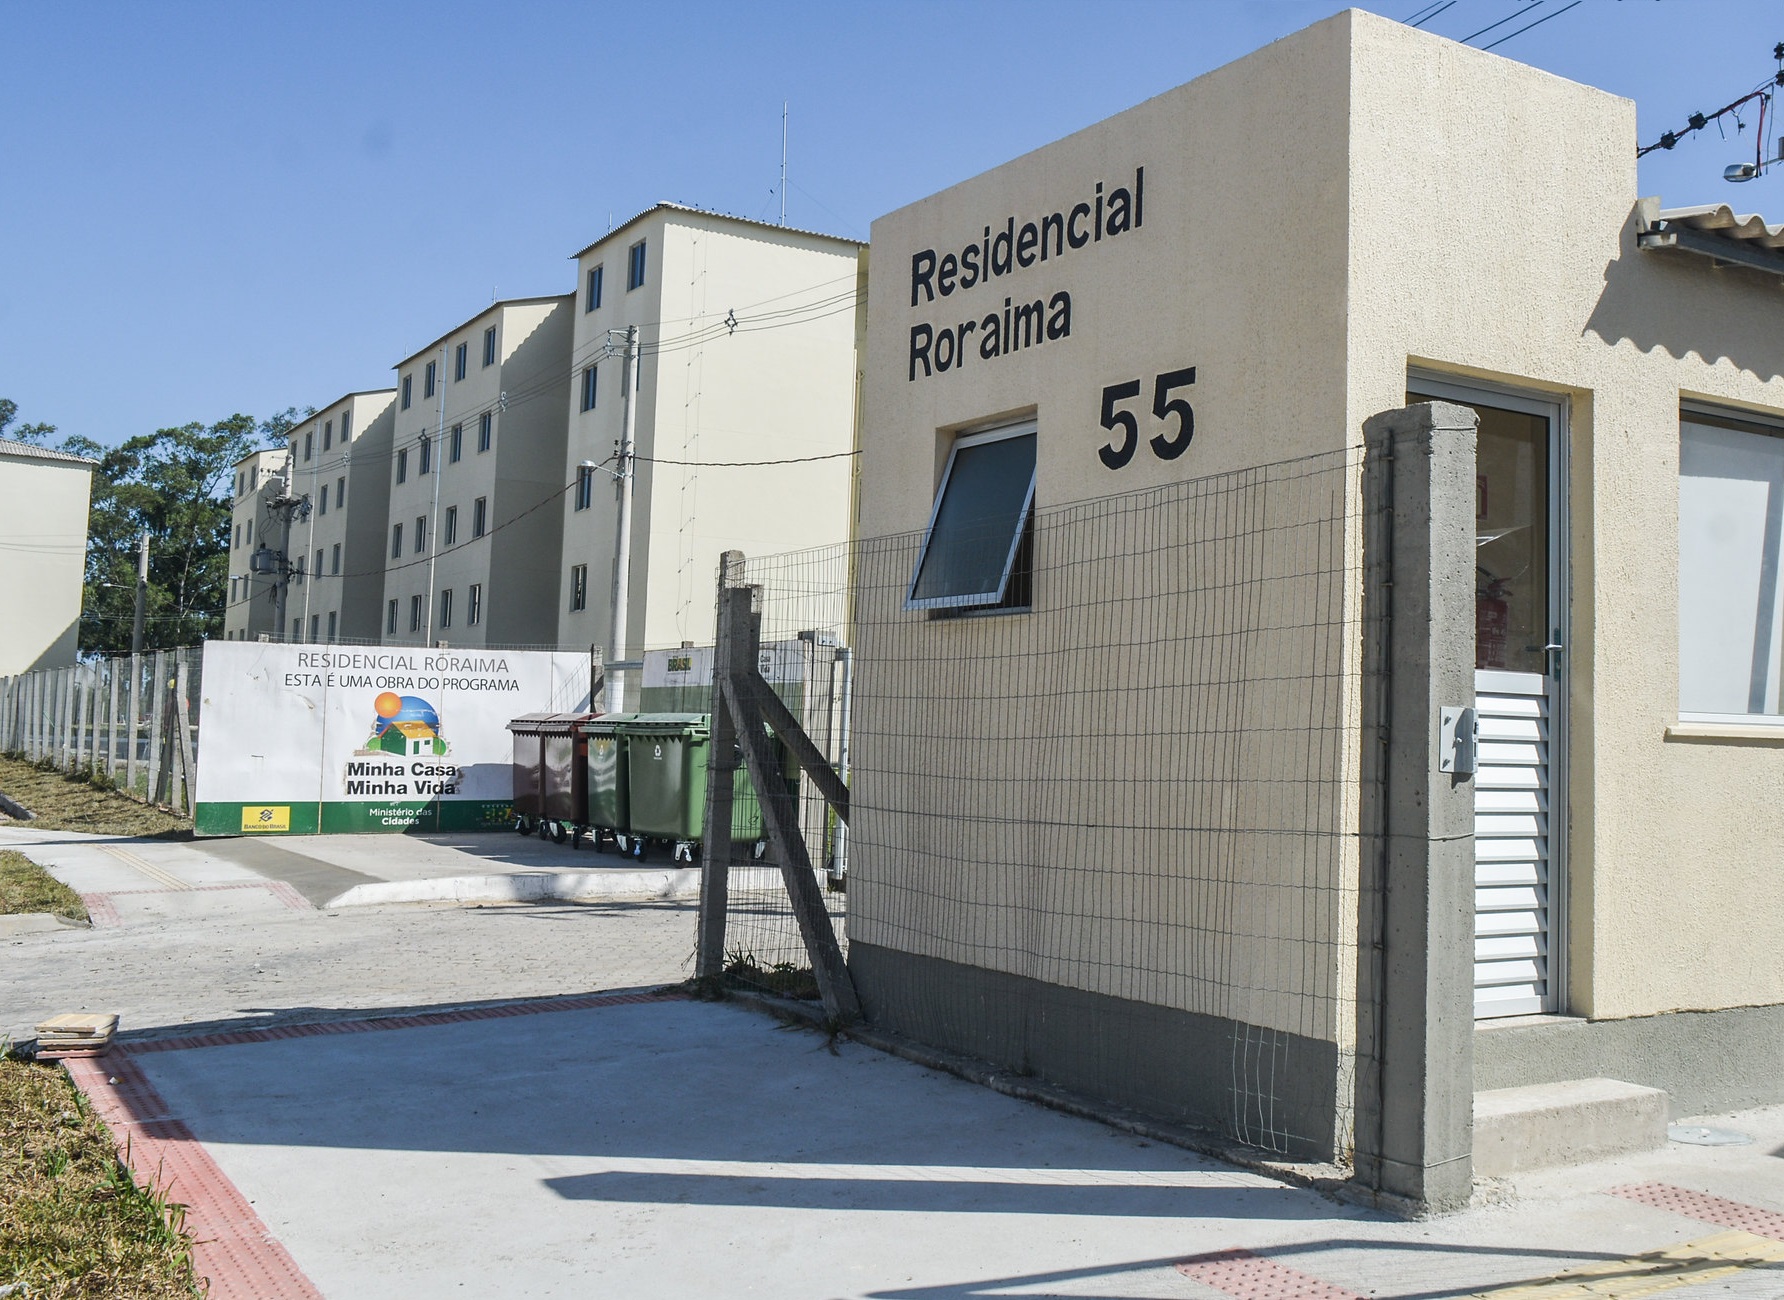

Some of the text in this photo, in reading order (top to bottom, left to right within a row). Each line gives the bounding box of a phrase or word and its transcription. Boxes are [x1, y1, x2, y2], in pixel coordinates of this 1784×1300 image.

[911, 165, 1144, 307] Residencial
[909, 290, 1072, 381] Roraima
[1098, 366, 1197, 470] 55
[298, 652, 509, 673] RESIDENCIAL RORAIMA
[667, 657, 692, 672] BRASIL
[284, 672, 520, 692] ESTA É UMA OBRA DO PROGRAMA
[347, 762, 456, 777] Minha Casa
[347, 780, 456, 795] Minha Vida
[369, 807, 432, 817] Ministério das
[381, 816, 420, 826] Cidades
